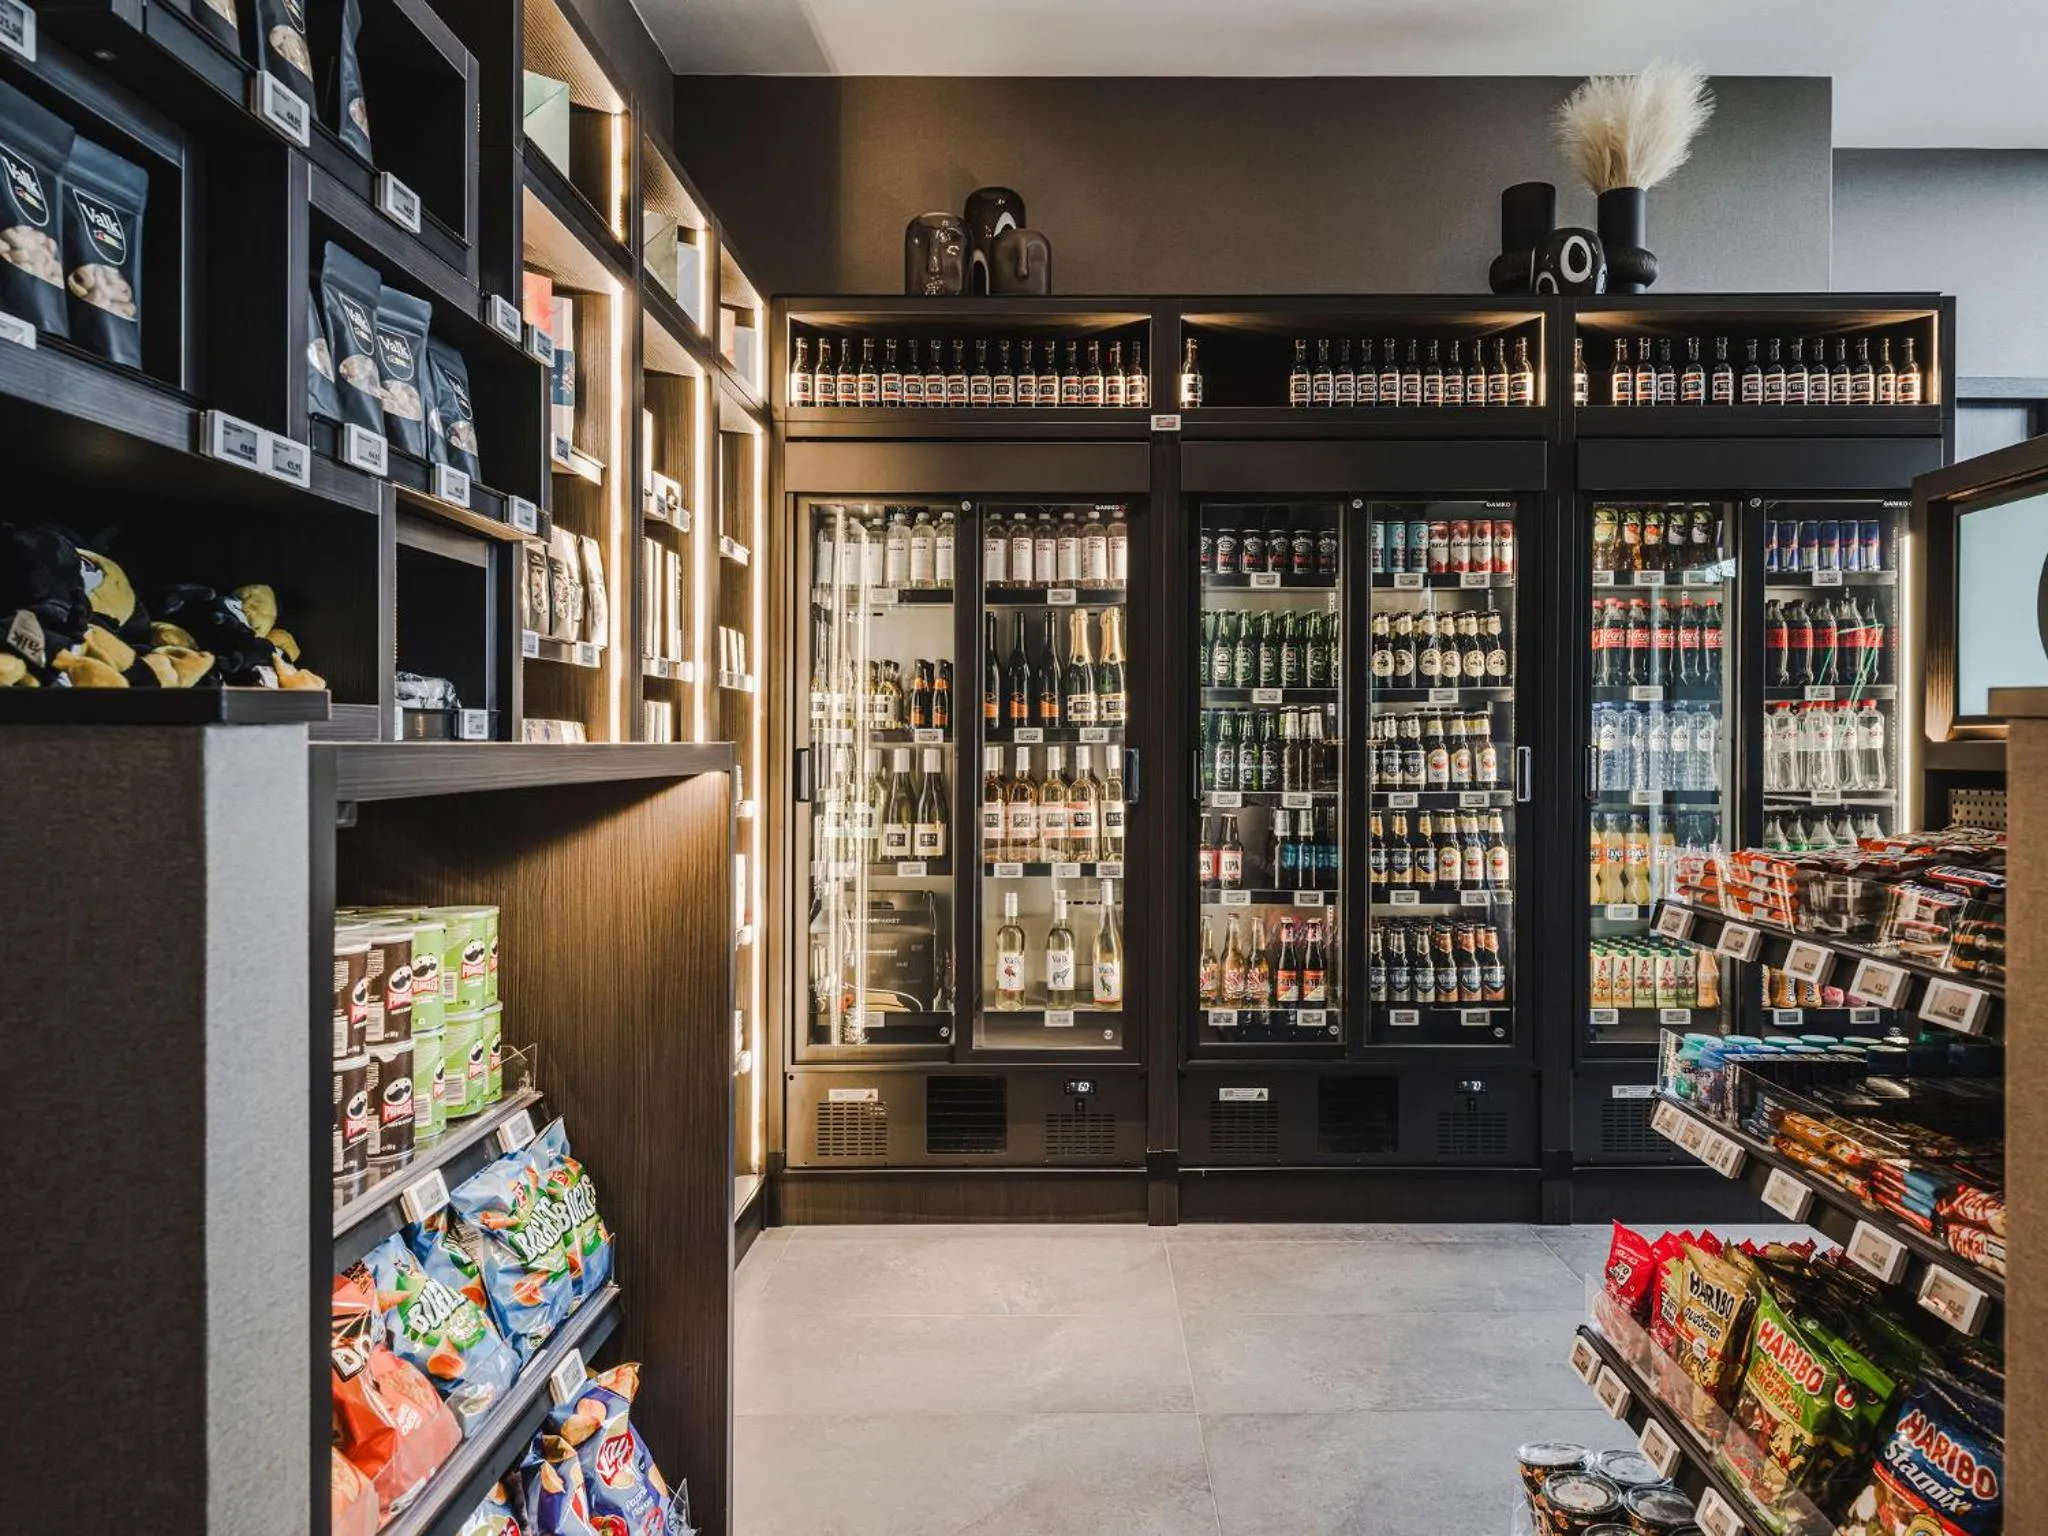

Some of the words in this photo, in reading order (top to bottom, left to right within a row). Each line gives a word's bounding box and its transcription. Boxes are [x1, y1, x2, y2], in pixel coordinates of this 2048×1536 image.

[80, 202, 123, 240] Valk
[378, 335, 412, 360] Valk
[1223, 859, 1239, 872] IPA
[1689, 1271, 1737, 1320] HARIBO
[1757, 1318, 1827, 1395] HARIBO
[1884, 1441, 1967, 1512] Starmix
[1896, 1408, 1998, 1500] HARIBO
